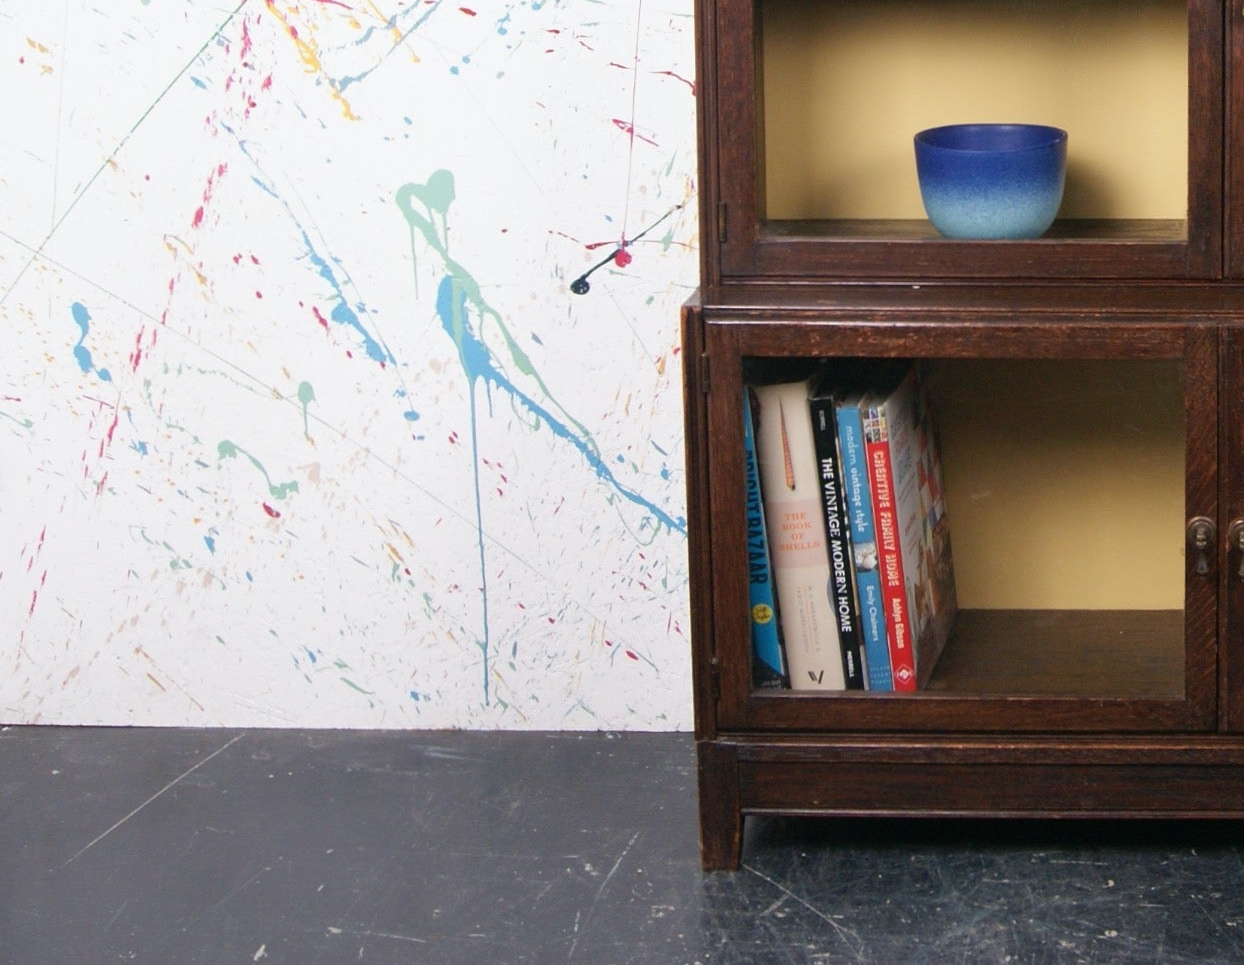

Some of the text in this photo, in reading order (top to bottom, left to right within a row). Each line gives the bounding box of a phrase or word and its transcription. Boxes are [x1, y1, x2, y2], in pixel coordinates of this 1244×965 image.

[846, 425, 868, 533] modern vintage style
[782, 522, 812, 531] BOOK
[784, 511, 807, 520] THE
[873, 451, 900, 587] CREATIVE FAMILY HOME
[748, 517, 769, 584] BAZAAR
[779, 541, 820, 552] SHELLS
[821, 457, 852, 633] THE VINTAGE MODERN HOME
[866, 585, 875, 606] Emily
[892, 598, 902, 623] Ashlyn
